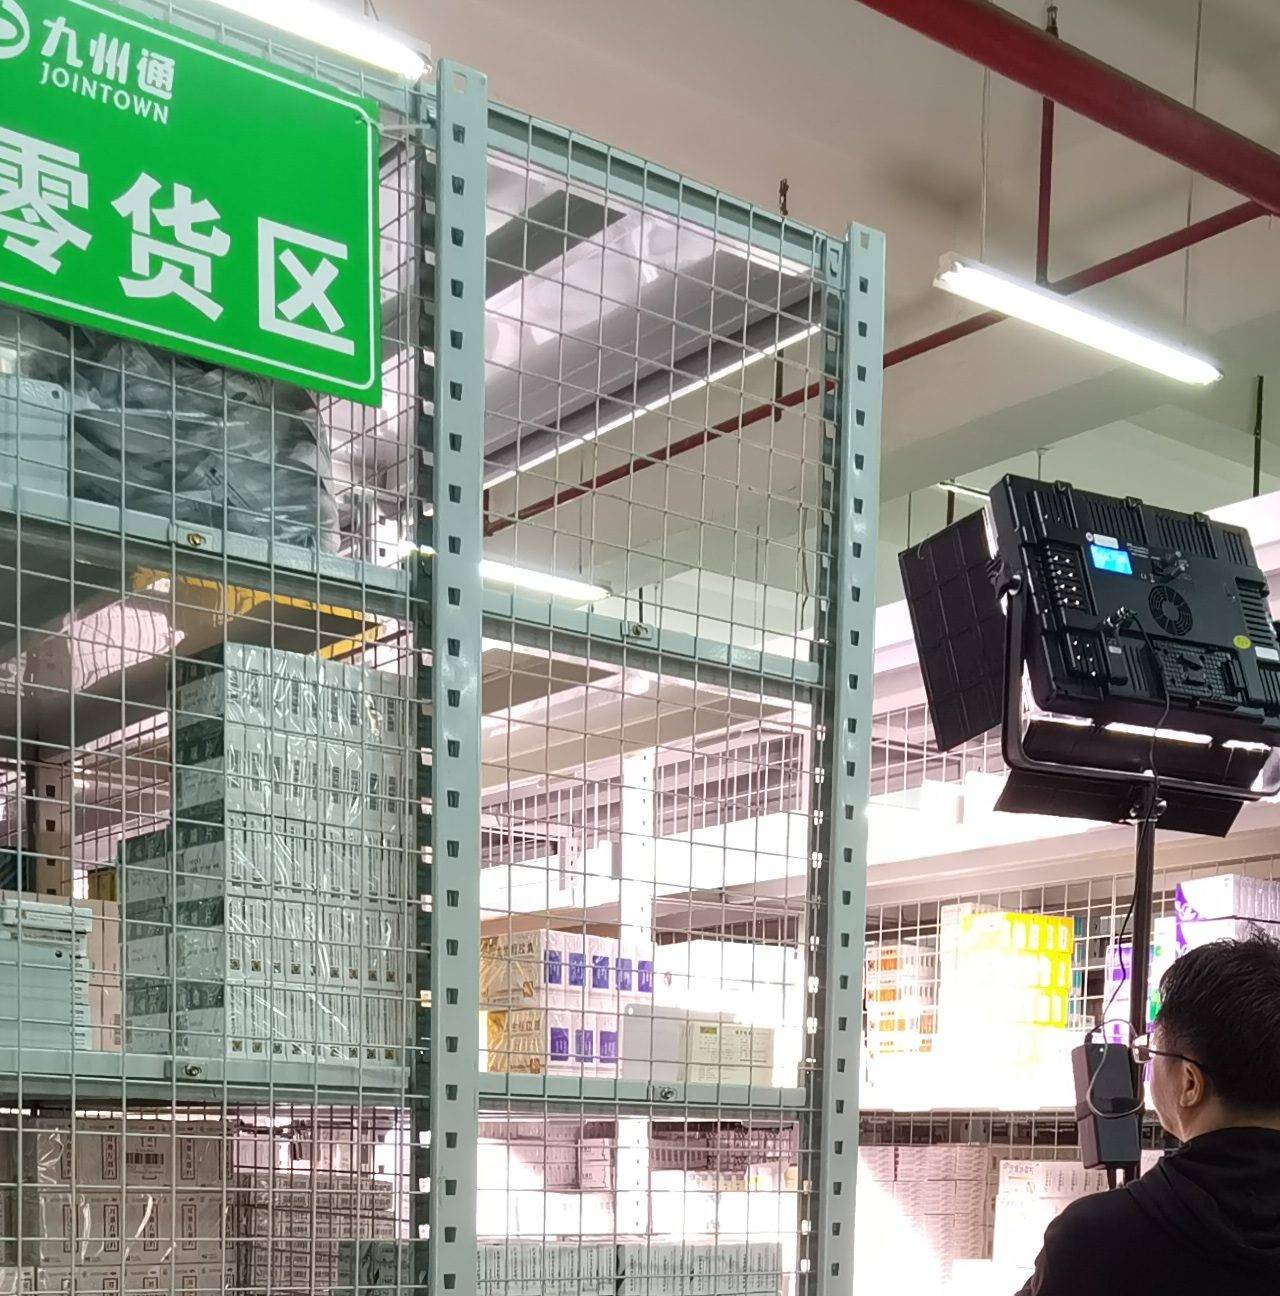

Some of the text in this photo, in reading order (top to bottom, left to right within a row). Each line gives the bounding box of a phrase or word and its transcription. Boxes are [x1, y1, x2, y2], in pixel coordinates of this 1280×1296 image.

[39, 61, 169, 126] JOINTOWN
[41, 15, 176, 101] 九州通
